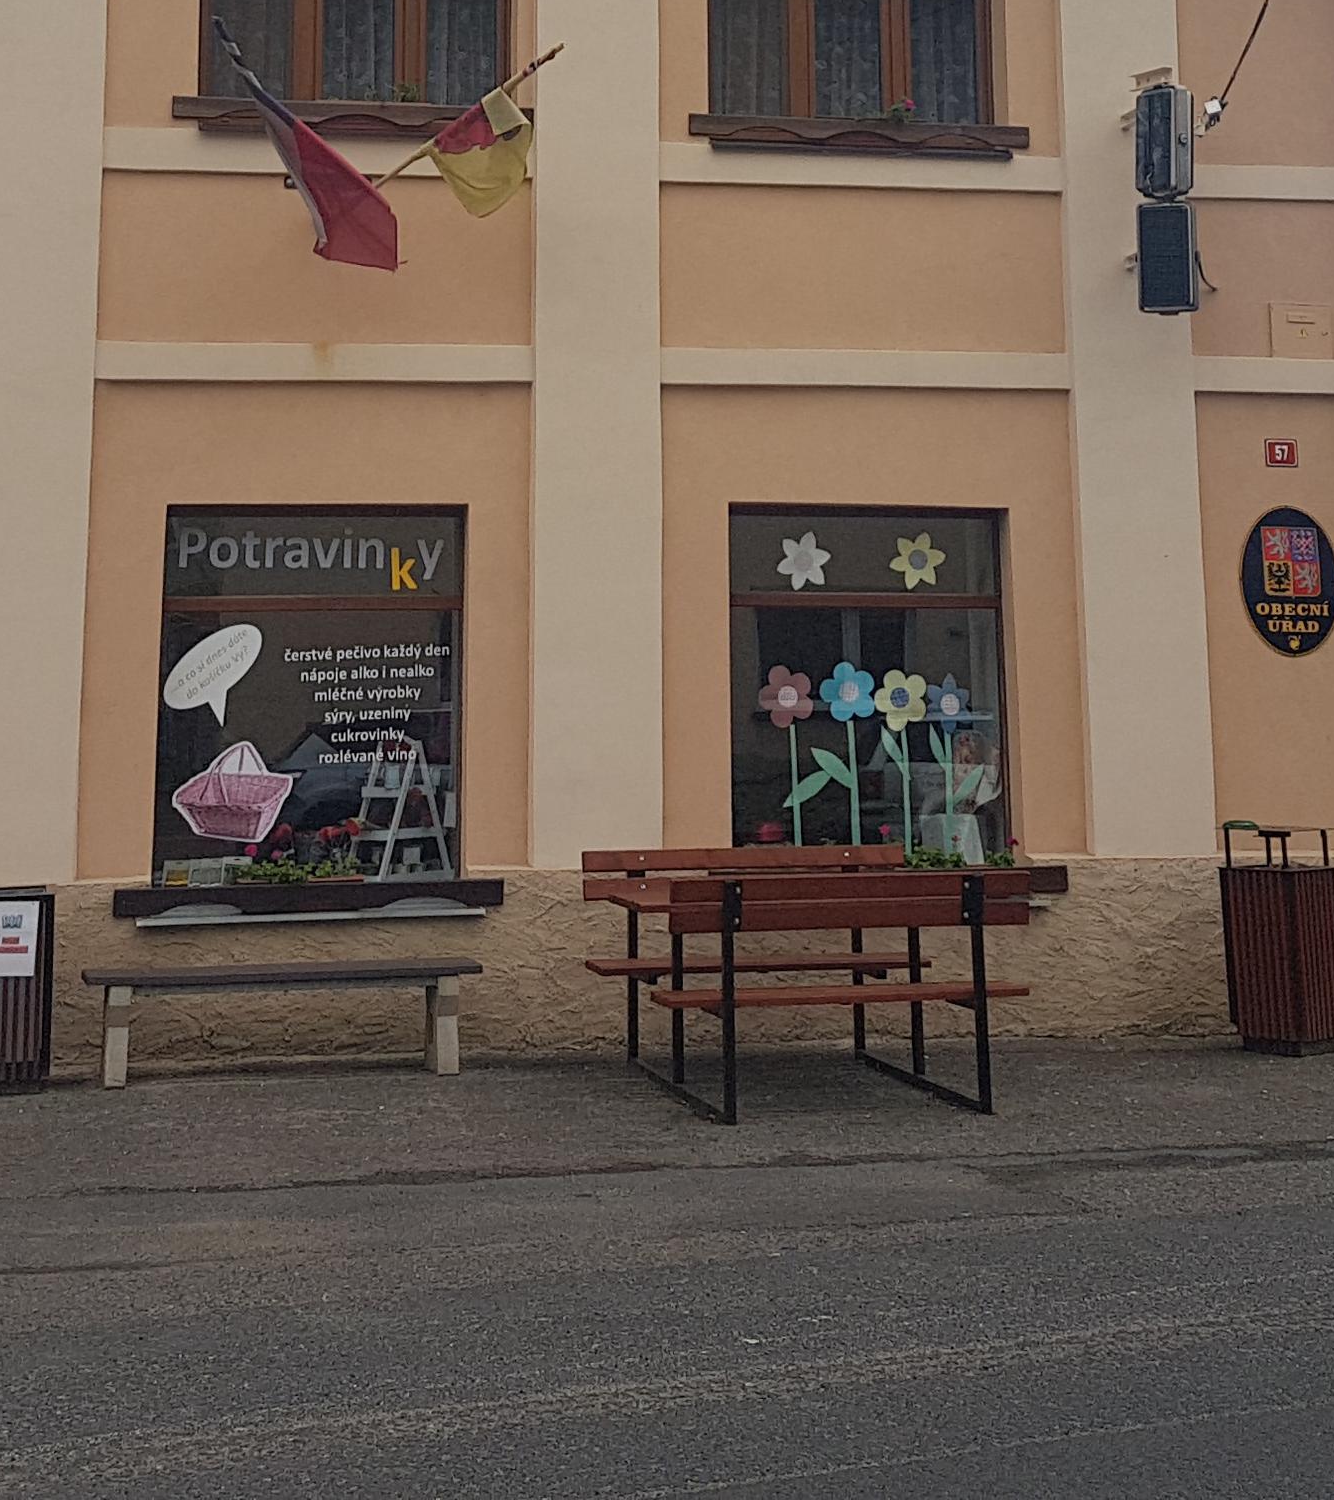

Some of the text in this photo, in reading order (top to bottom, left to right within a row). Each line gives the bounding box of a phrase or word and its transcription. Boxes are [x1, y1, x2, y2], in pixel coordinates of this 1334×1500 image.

[1274, 444, 1289, 461] 57
[177, 526, 445, 591] Potravinky
[1255, 601, 1331, 617] OBECNÍ
[1266, 616, 1320, 633] ÚŘAD
[284, 643, 450, 663] čerstvé pečivo každý den
[300, 664, 435, 684] nápoje alko i nealko
[314, 685, 421, 702] mléčné výrobky
[324, 708, 356, 724] sýry,
[331, 726, 405, 743] cukrovinky
[318, 749, 384, 765] rozlévané
